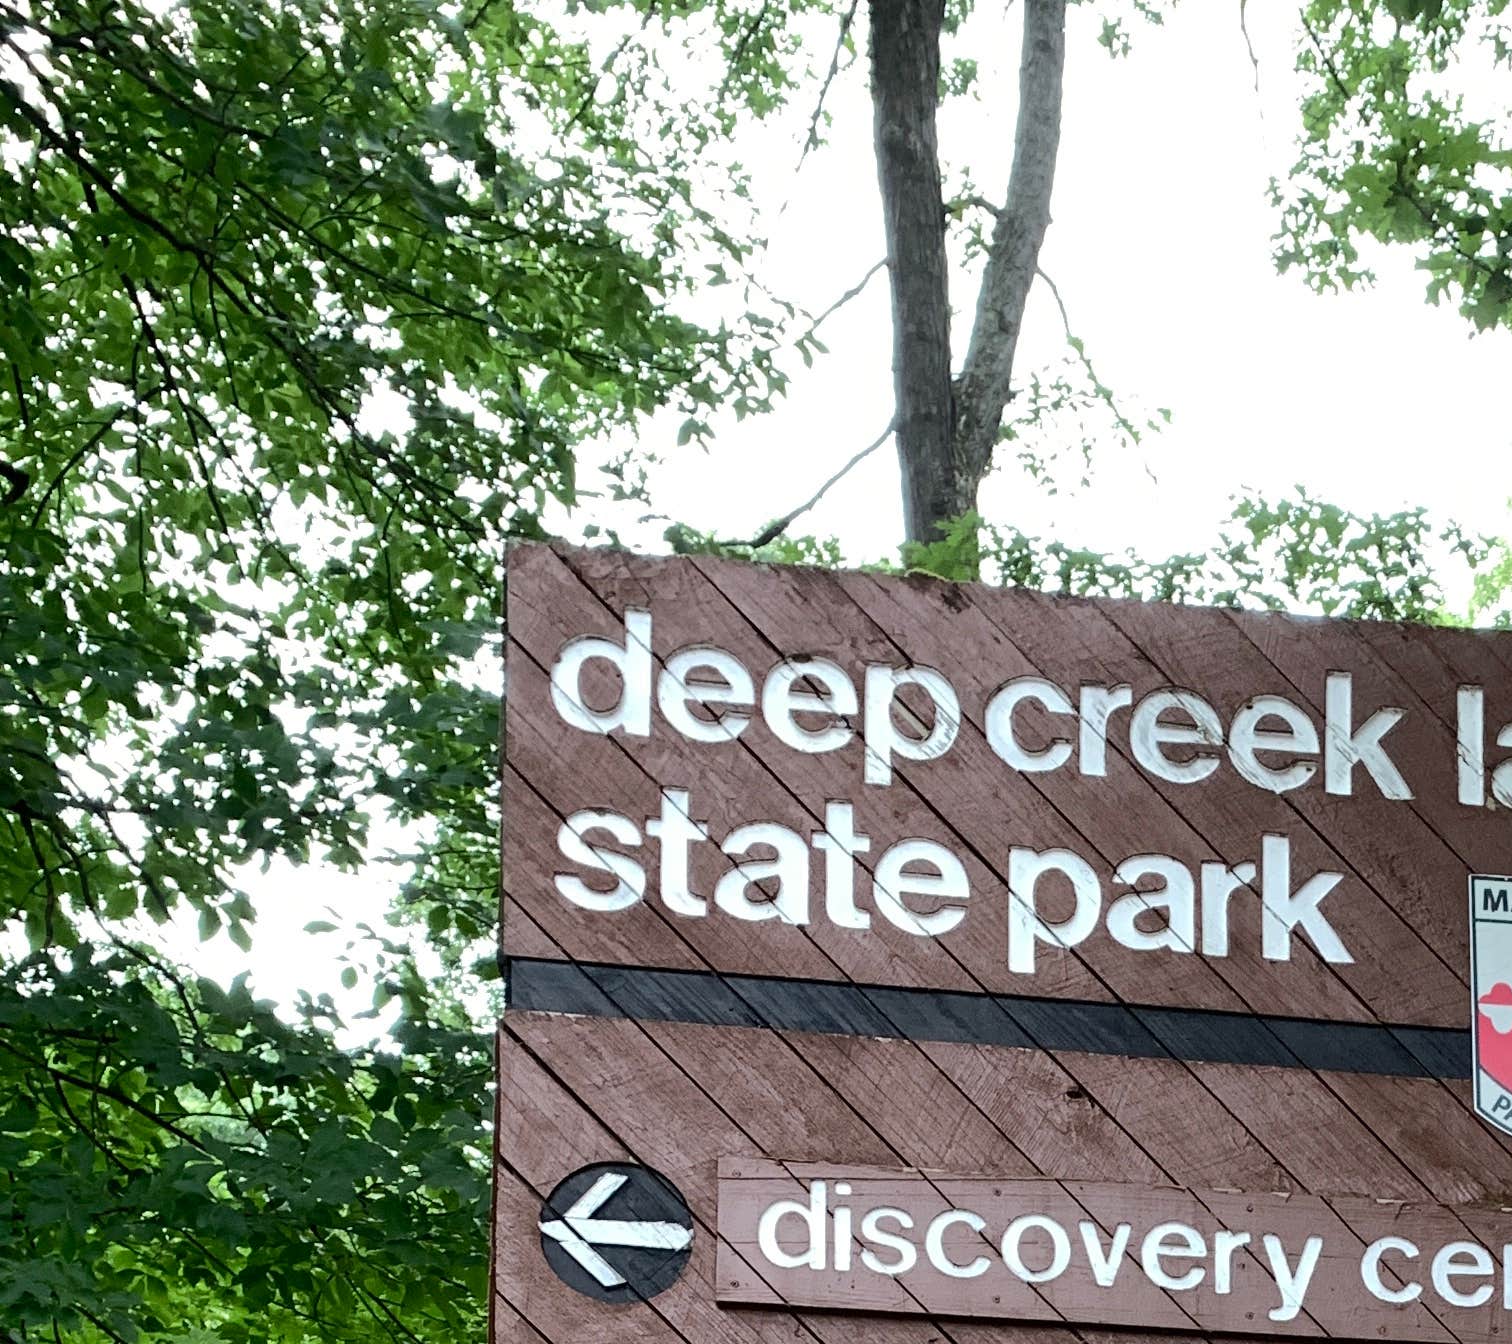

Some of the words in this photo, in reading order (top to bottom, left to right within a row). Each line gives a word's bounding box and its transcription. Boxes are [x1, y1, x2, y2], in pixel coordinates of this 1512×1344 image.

[549, 609, 962, 788] deep
[984, 668, 1413, 800] creek
[554, 787, 972, 938] state
[1007, 834, 1356, 975] park
[754, 1178, 1325, 1323] discovery
